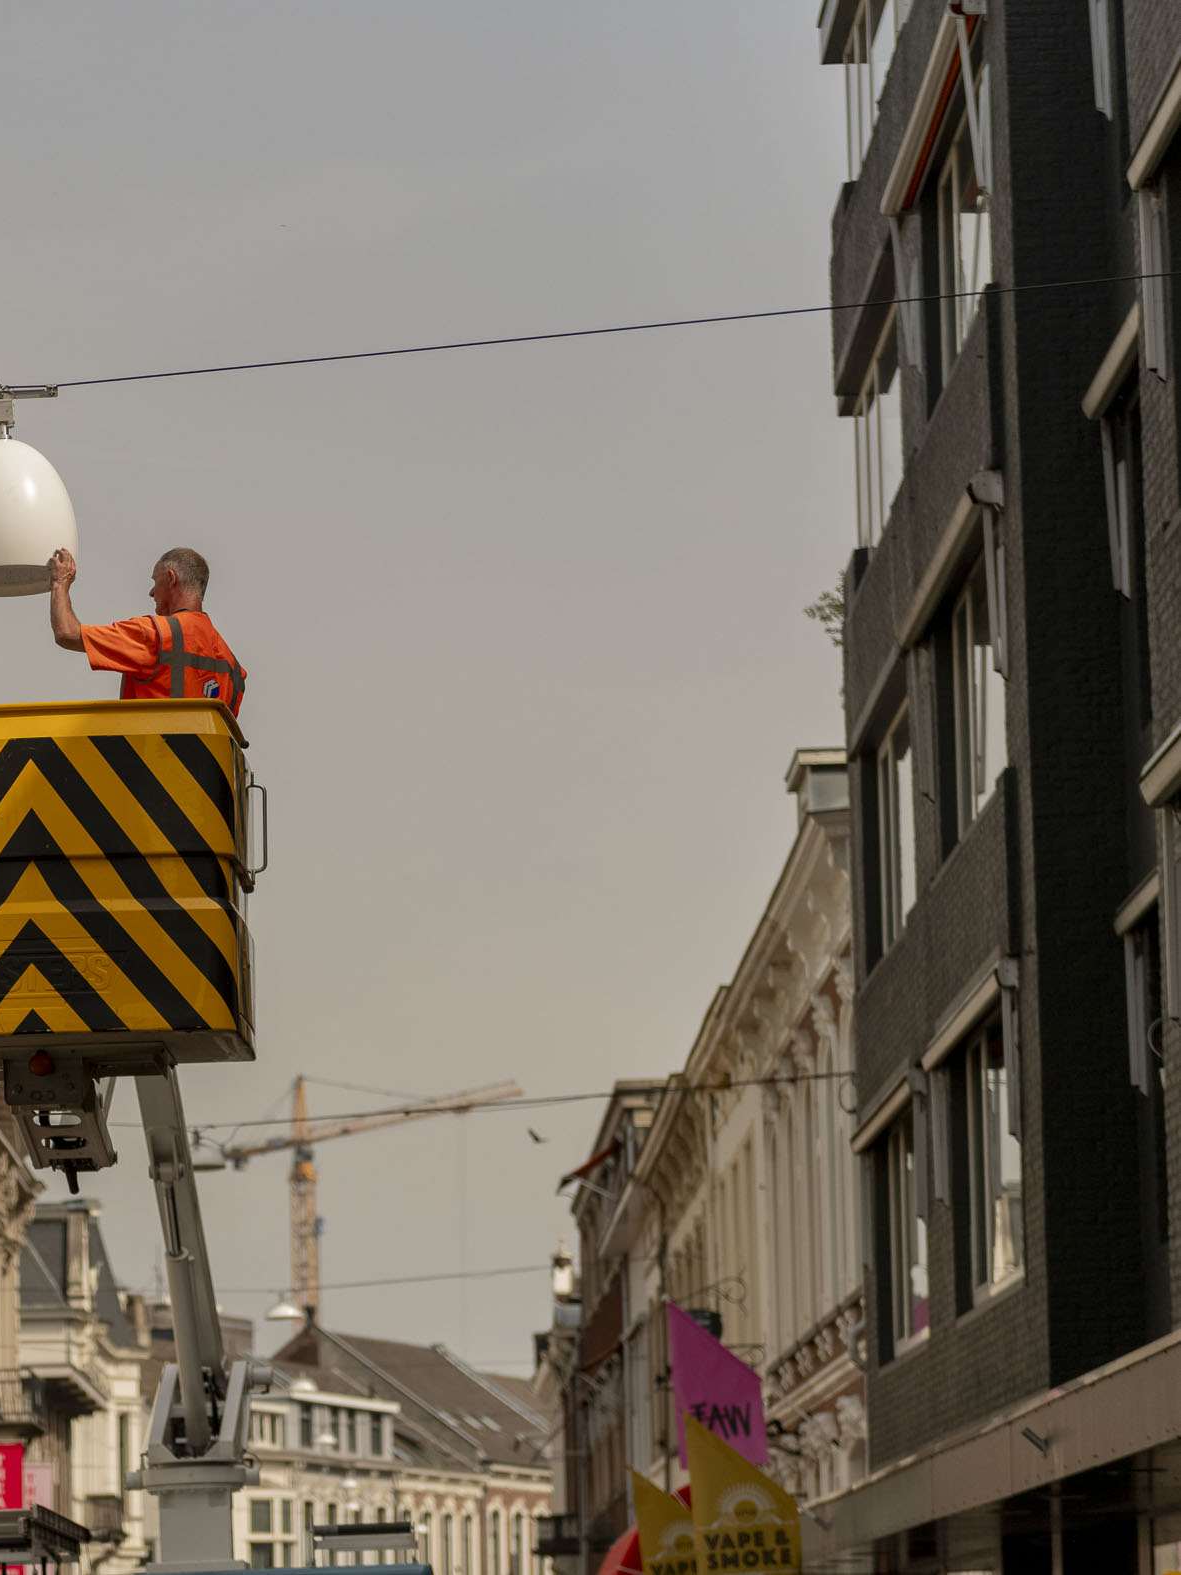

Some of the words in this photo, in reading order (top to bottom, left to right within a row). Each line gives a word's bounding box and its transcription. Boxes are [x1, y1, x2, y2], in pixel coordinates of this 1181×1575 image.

[704, 1530, 764, 1550] VAPE
[775, 1528, 790, 1545] &
[706, 1549, 792, 1570] SMOKE
